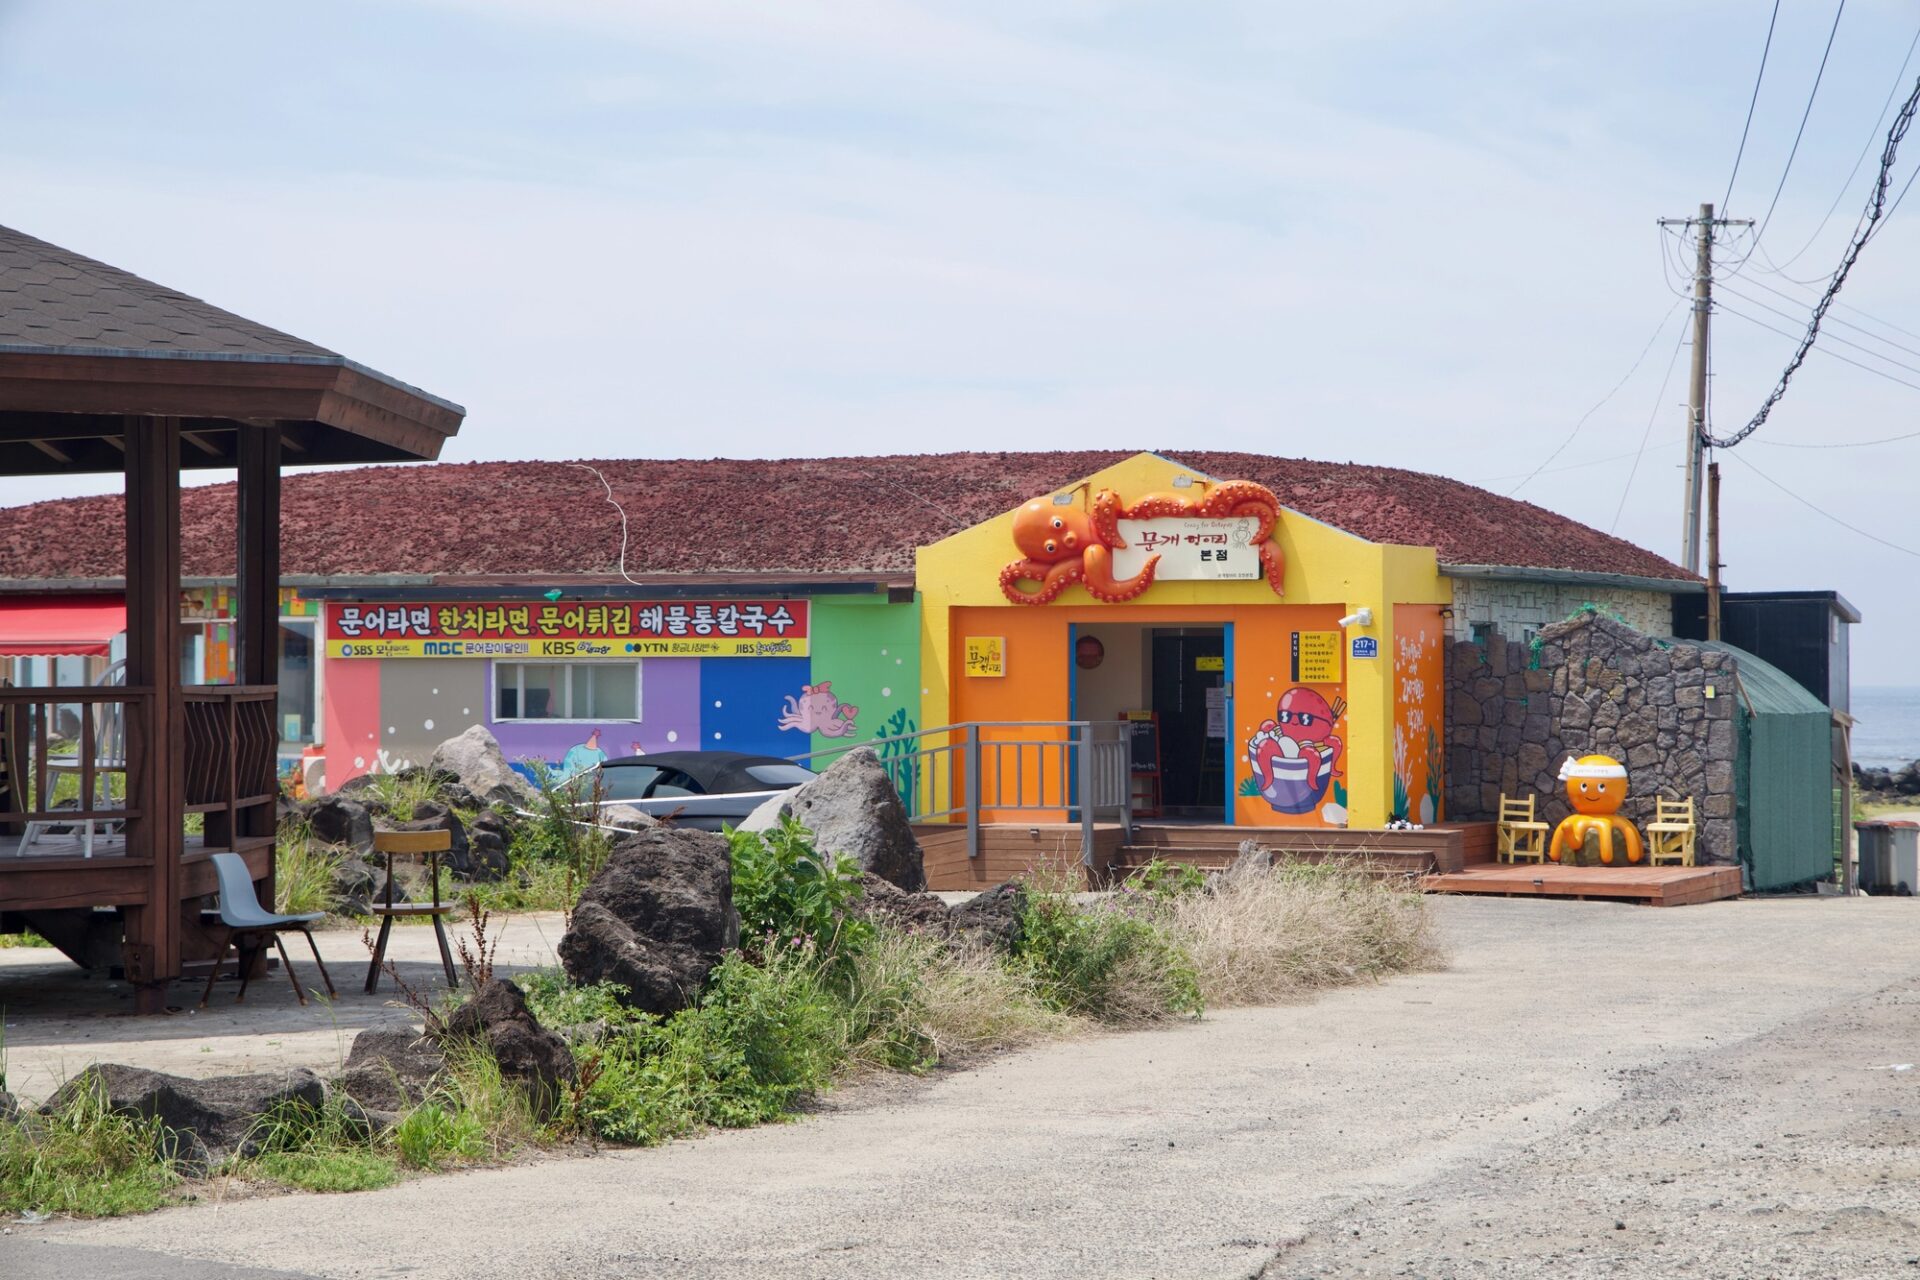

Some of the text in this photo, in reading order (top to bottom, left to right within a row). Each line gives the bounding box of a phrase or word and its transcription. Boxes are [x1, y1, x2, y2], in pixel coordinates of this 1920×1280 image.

[639, 605, 795, 635] 해물통칼국수
[354, 645, 373, 655] SBS
[424, 642, 463, 655] MBC
[543, 642, 575, 655] KBS
[643, 643, 668, 653] YTN
[736, 643, 755, 654] JIBS
[1355, 640, 1375, 649] 217-1
